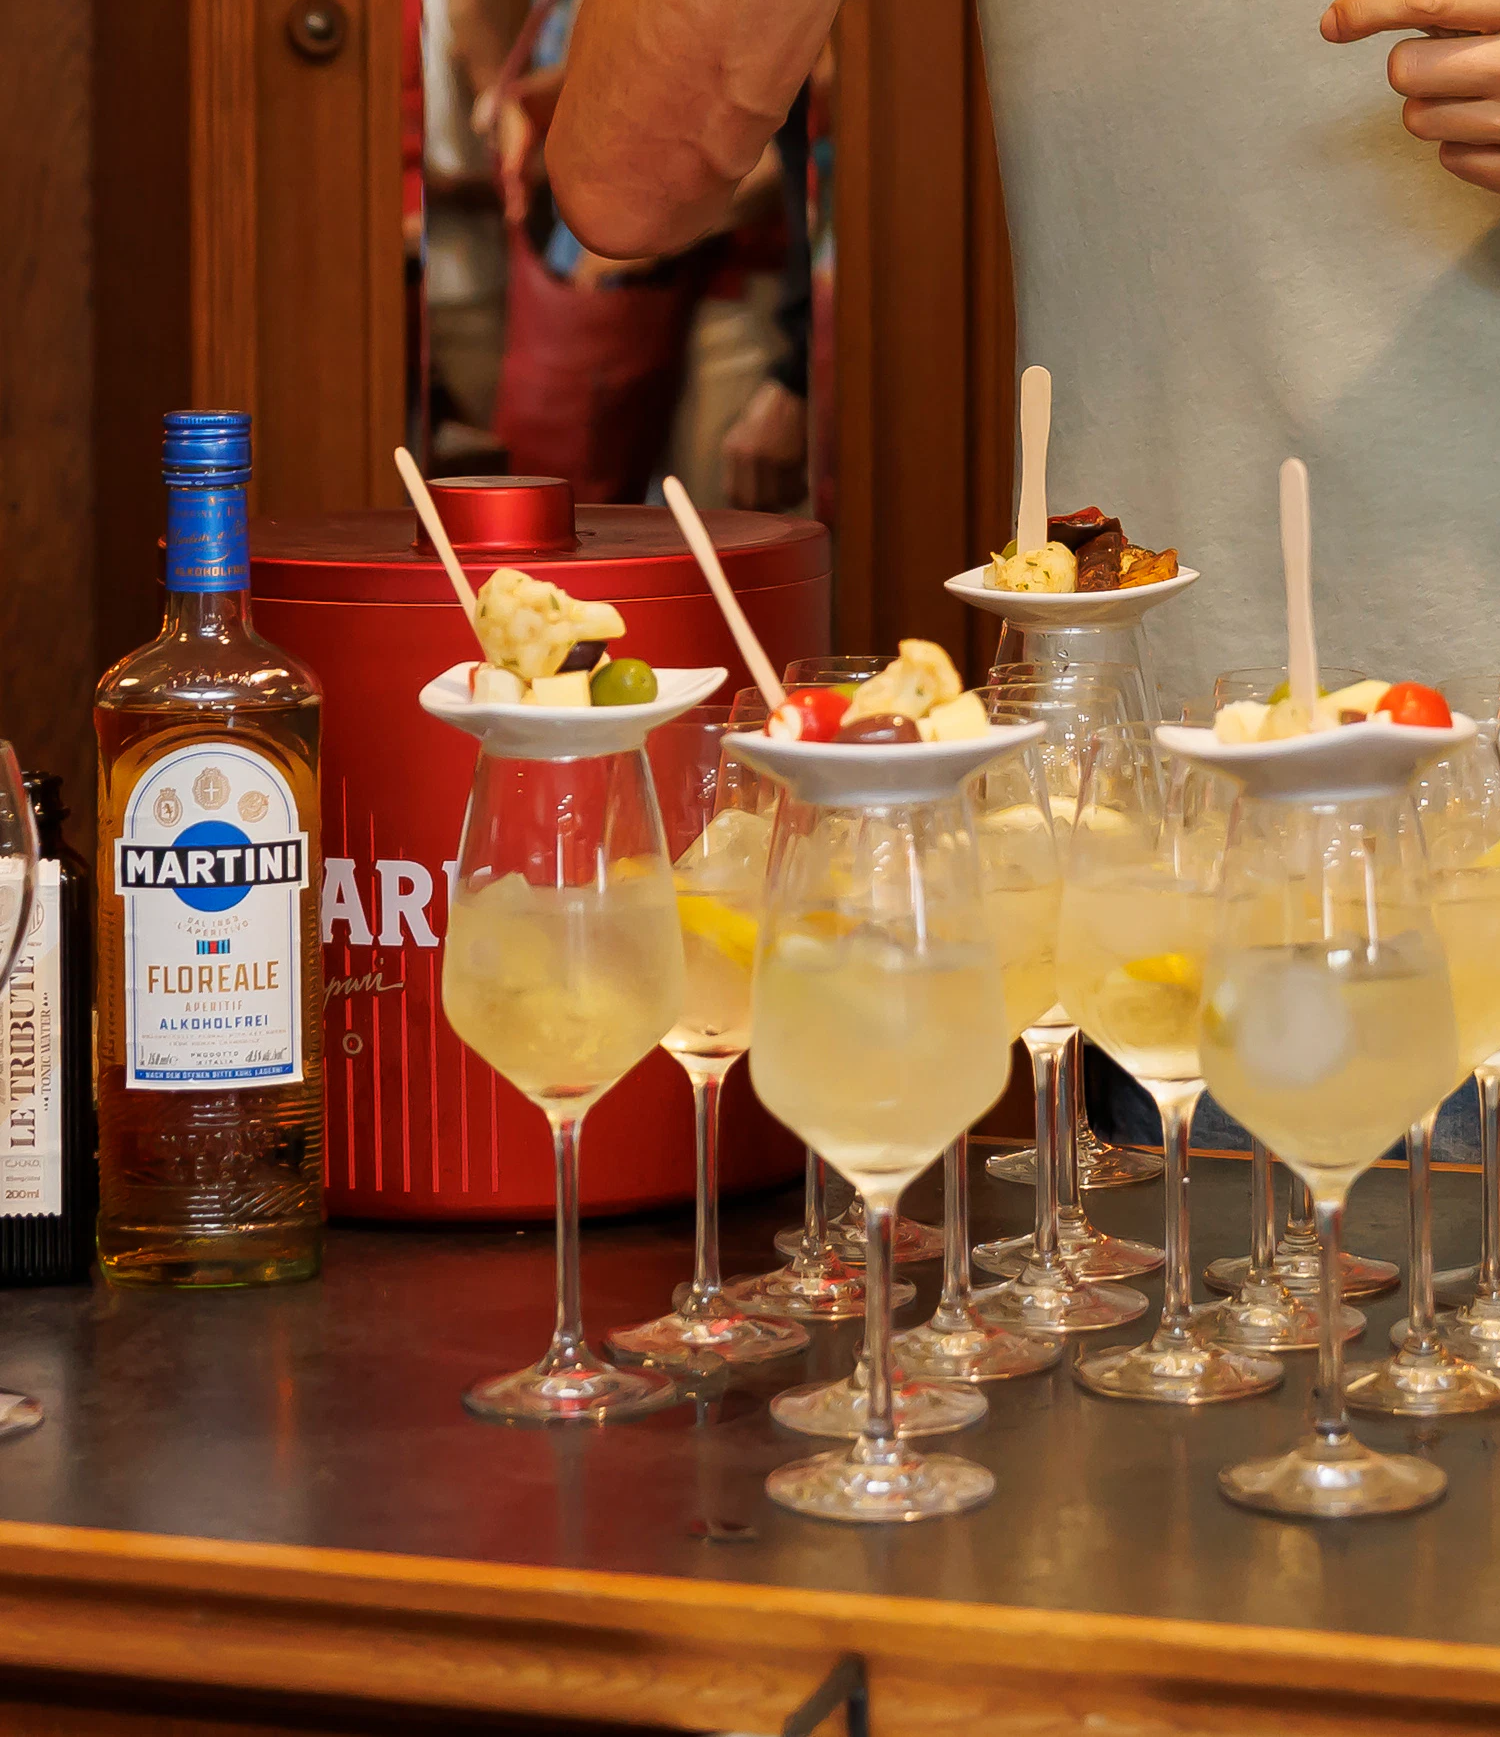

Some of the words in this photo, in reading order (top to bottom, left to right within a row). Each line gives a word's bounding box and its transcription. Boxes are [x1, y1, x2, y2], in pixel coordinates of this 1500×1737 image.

[126, 844, 297, 885] MARTINI
[148, 961, 279, 994] FLOREALE
[9, 956, 35, 1101] TRIBUTE
[41, 1009, 51, 1054] WATER
[160, 1015, 269, 1030] ALKOHOLFREI
[41, 1055, 51, 1095] TONIC
[10, 1109, 35, 1148] LE
